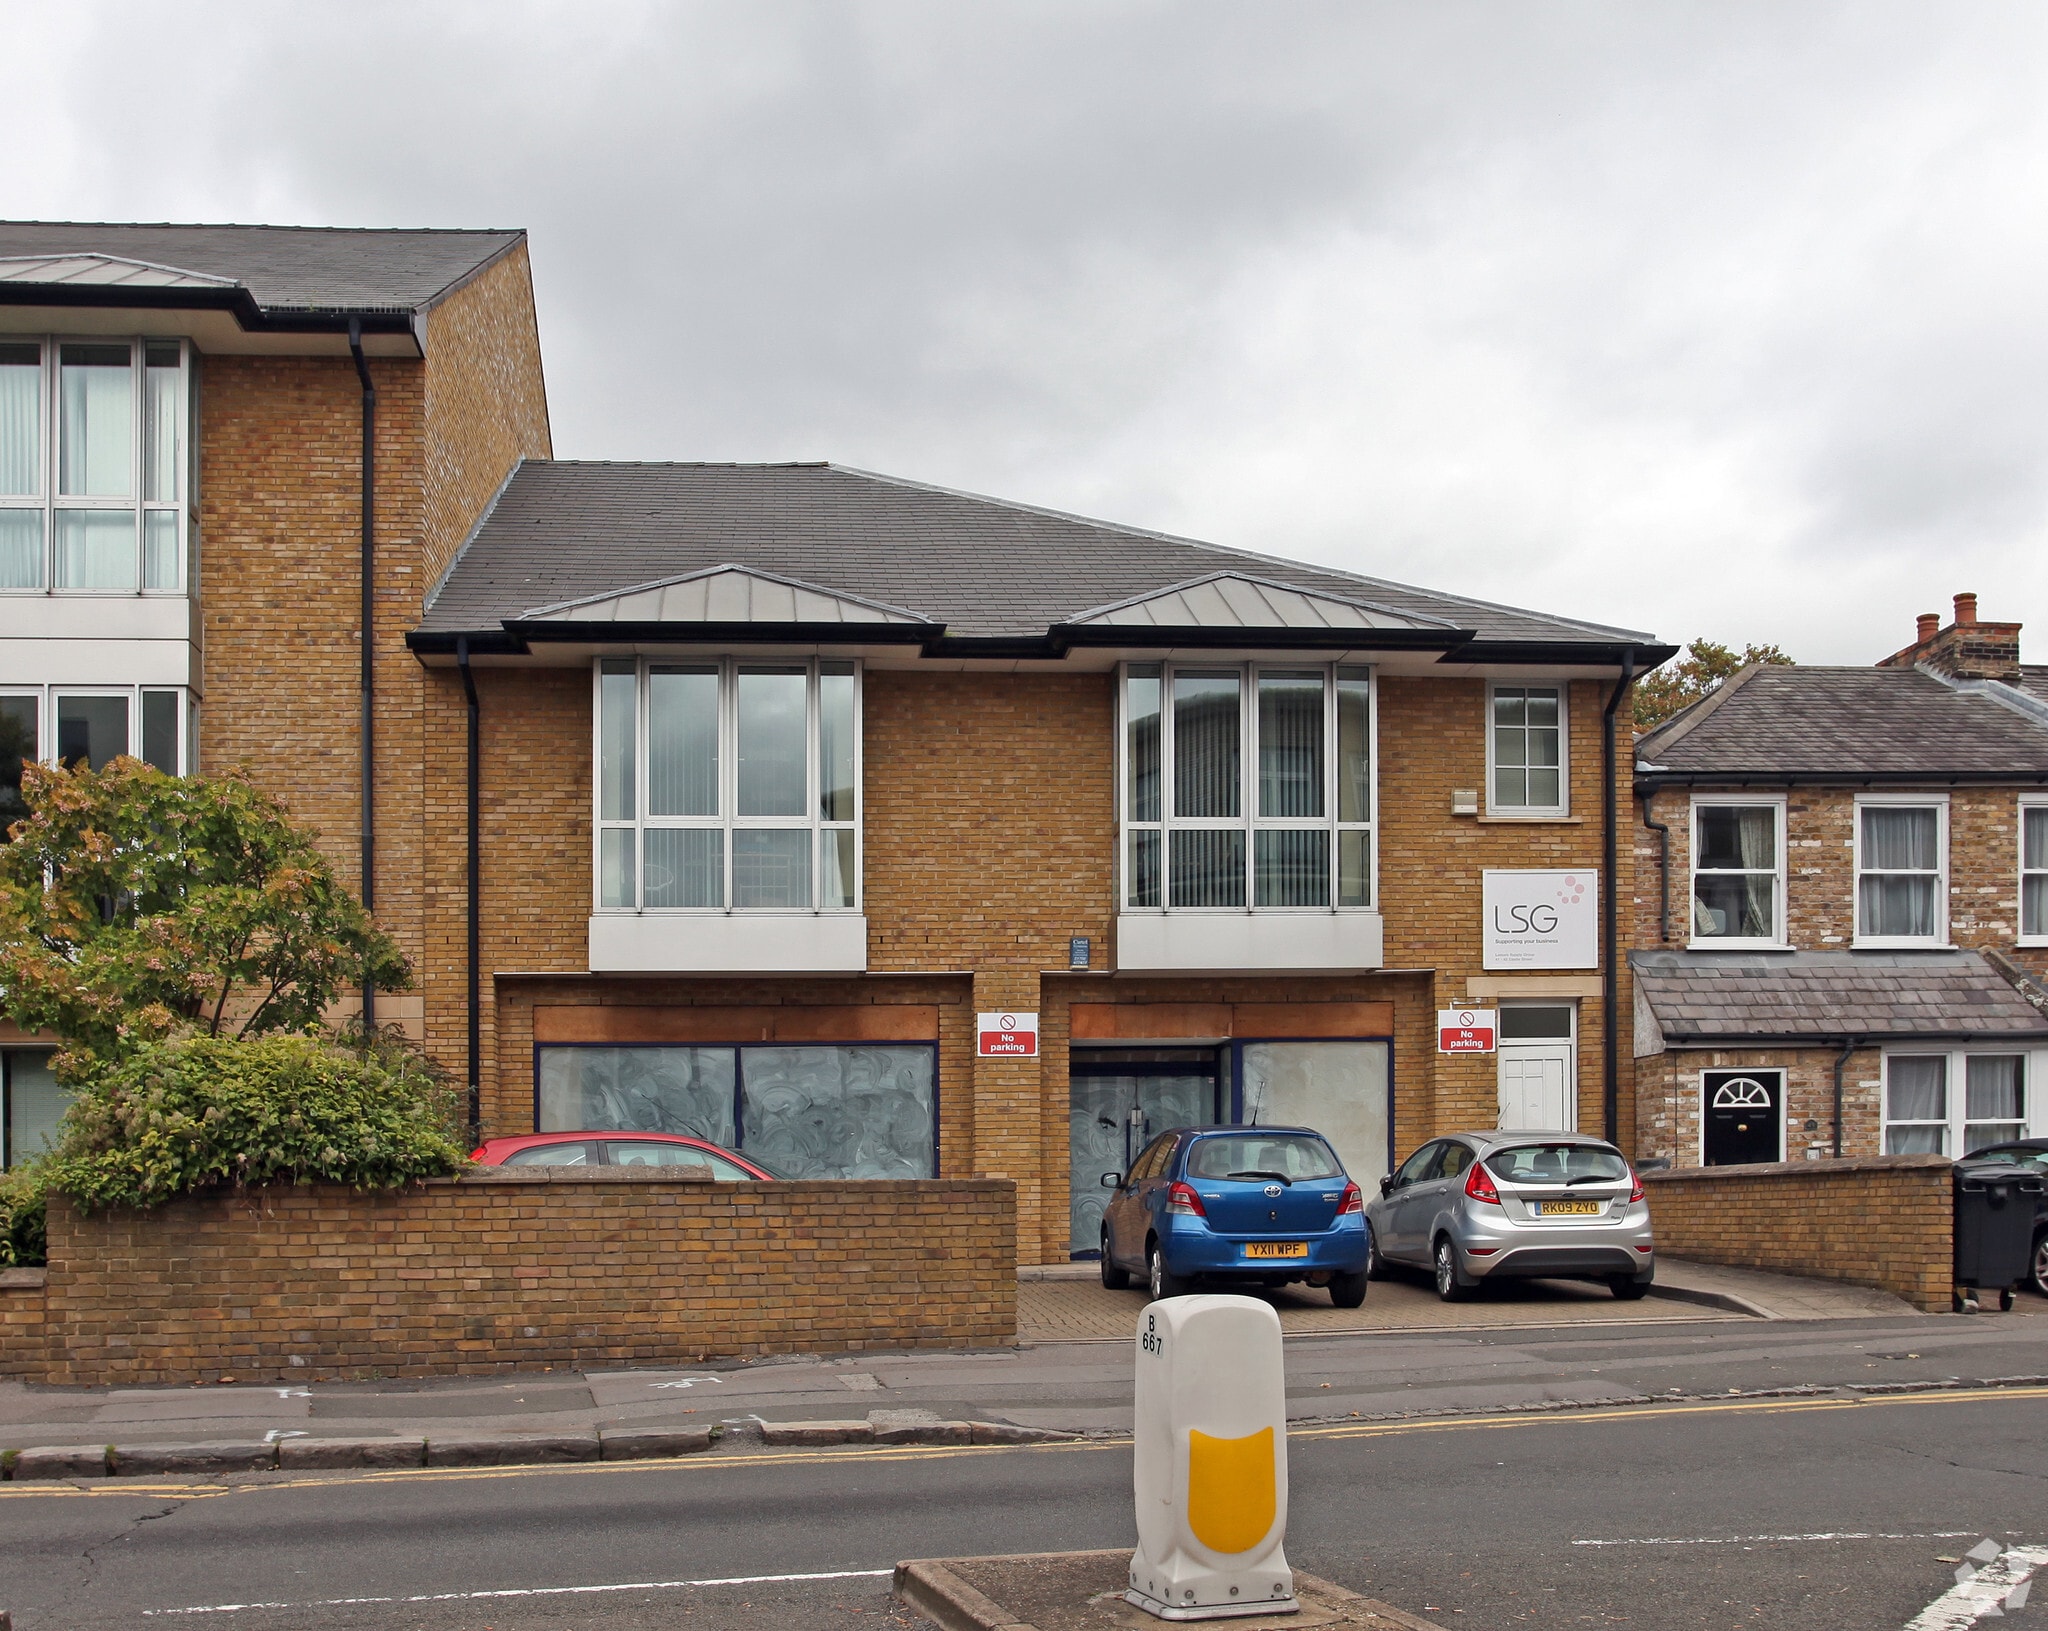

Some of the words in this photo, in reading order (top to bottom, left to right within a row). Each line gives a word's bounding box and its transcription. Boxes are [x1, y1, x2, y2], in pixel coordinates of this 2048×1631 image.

[1495, 905, 1558, 933] LSG
[1001, 1034, 1014, 1042] No
[1460, 1030, 1473, 1038] No
[990, 1043, 1025, 1053] parking
[1450, 1039, 1483, 1049] parking
[1542, 1202, 1573, 1213] RK09
[1252, 1244, 1274, 1255] YX11
[1277, 1244, 1300, 1254] WPF
[1149, 1314, 1155, 1332] B
[1143, 1332, 1162, 1355] 667
